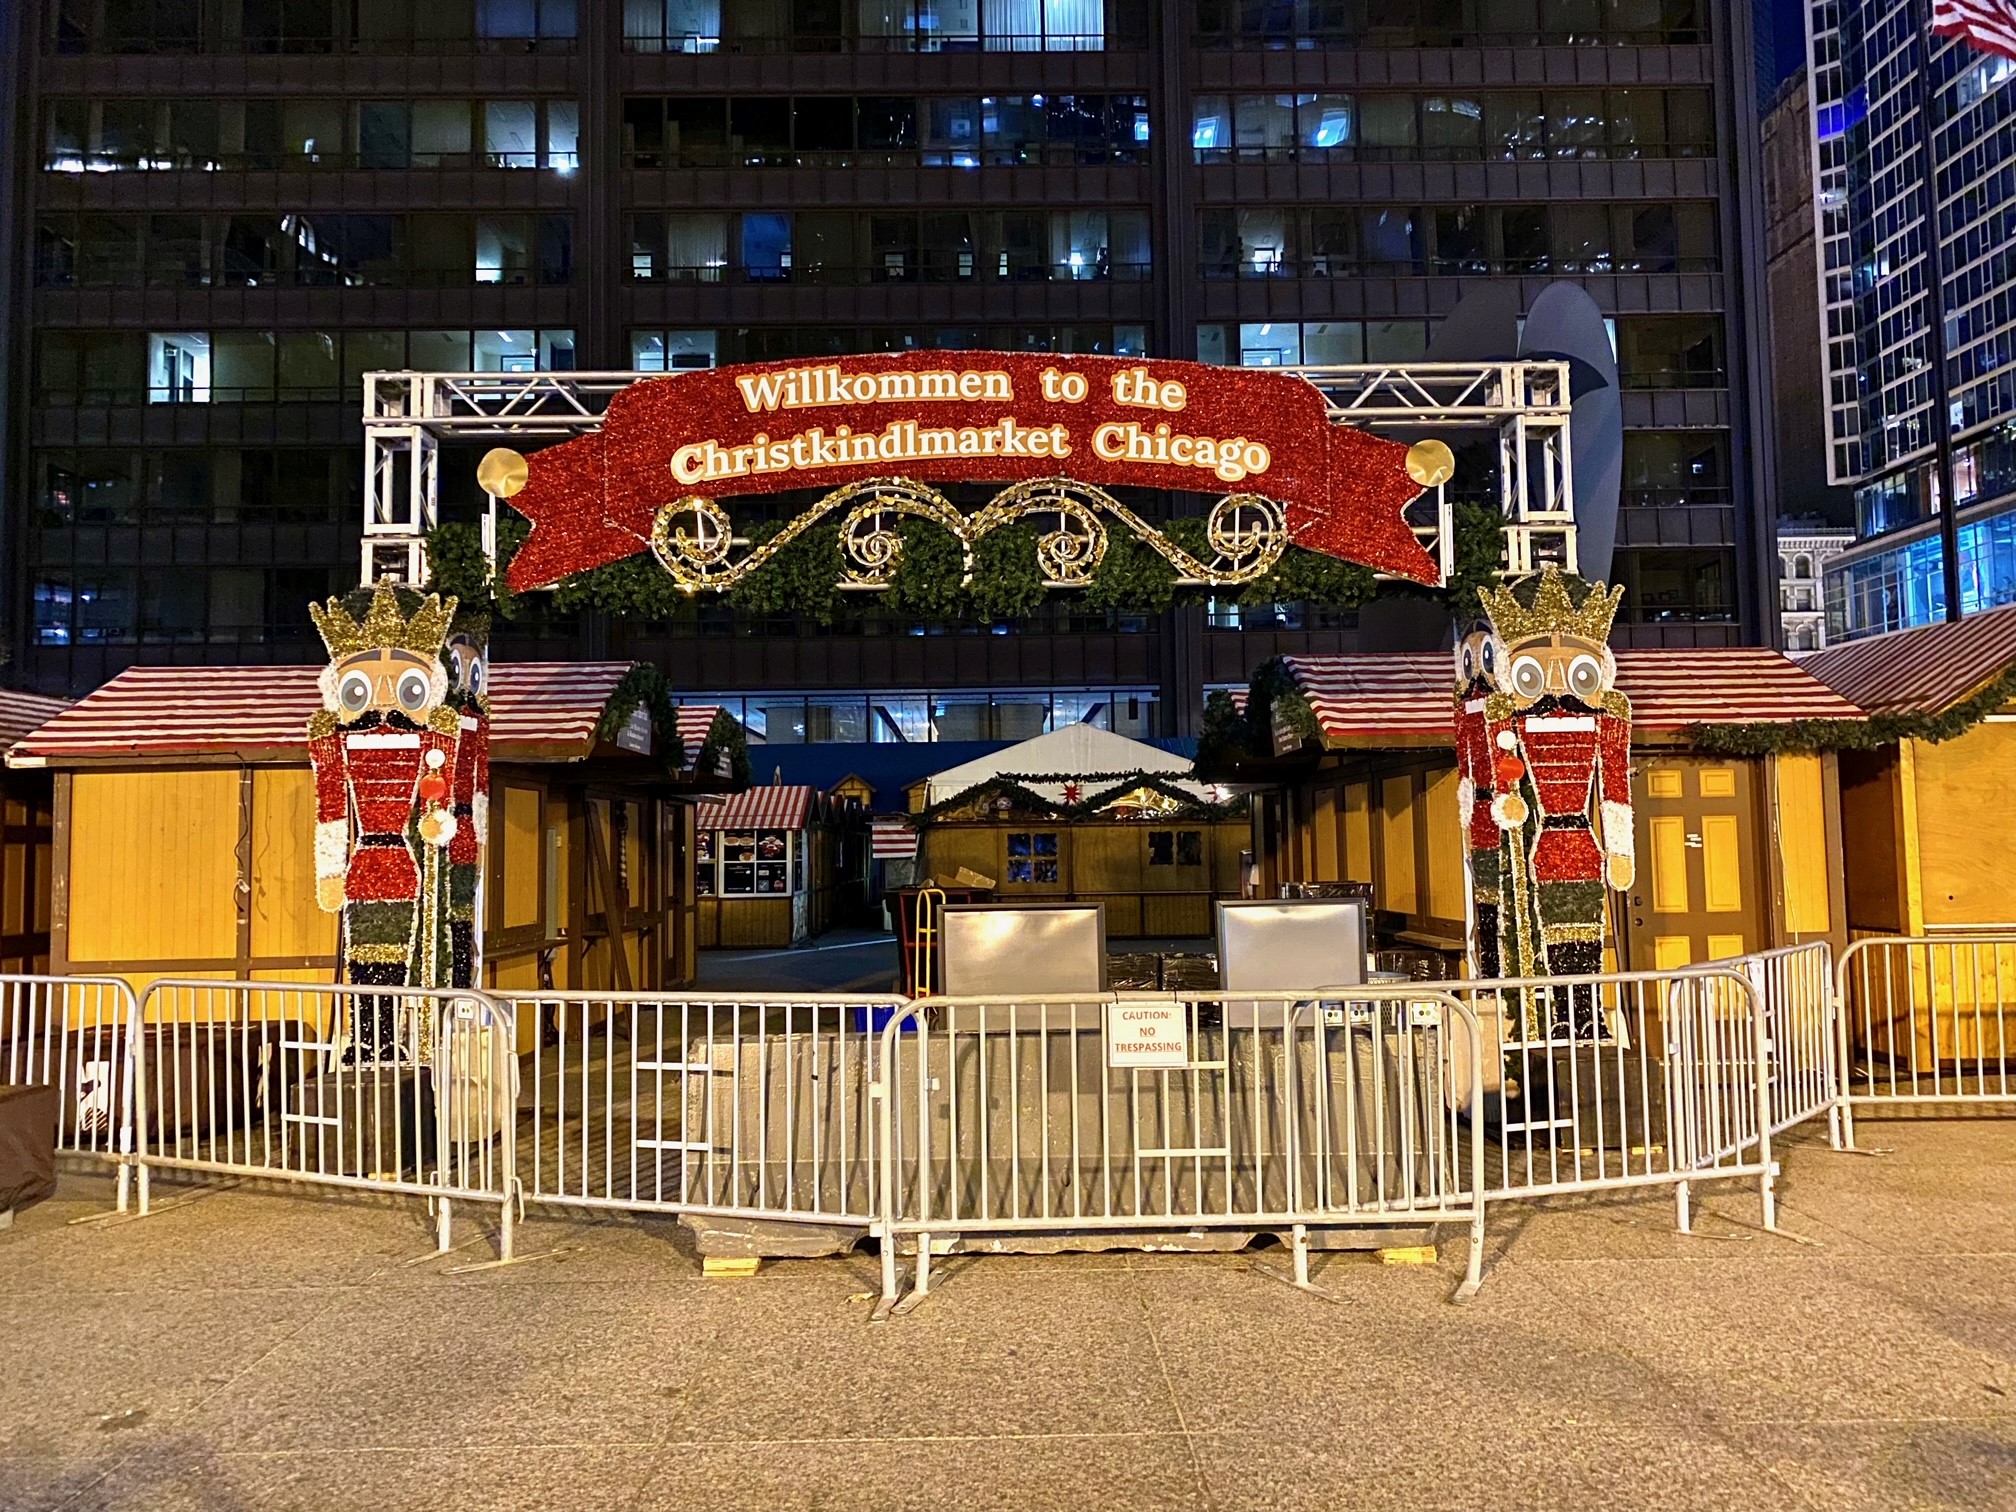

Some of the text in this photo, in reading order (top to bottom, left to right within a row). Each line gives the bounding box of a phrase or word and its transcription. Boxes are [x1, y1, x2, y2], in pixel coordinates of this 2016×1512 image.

[738, 367, 1186, 411] Willkommen to the
[672, 419, 1269, 482] Christkindlmarket Chicago
[1122, 1011, 1172, 1020] CAUTION:
[1139, 1027, 1156, 1037] NO
[1115, 1042, 1182, 1052] TRESPASSING
